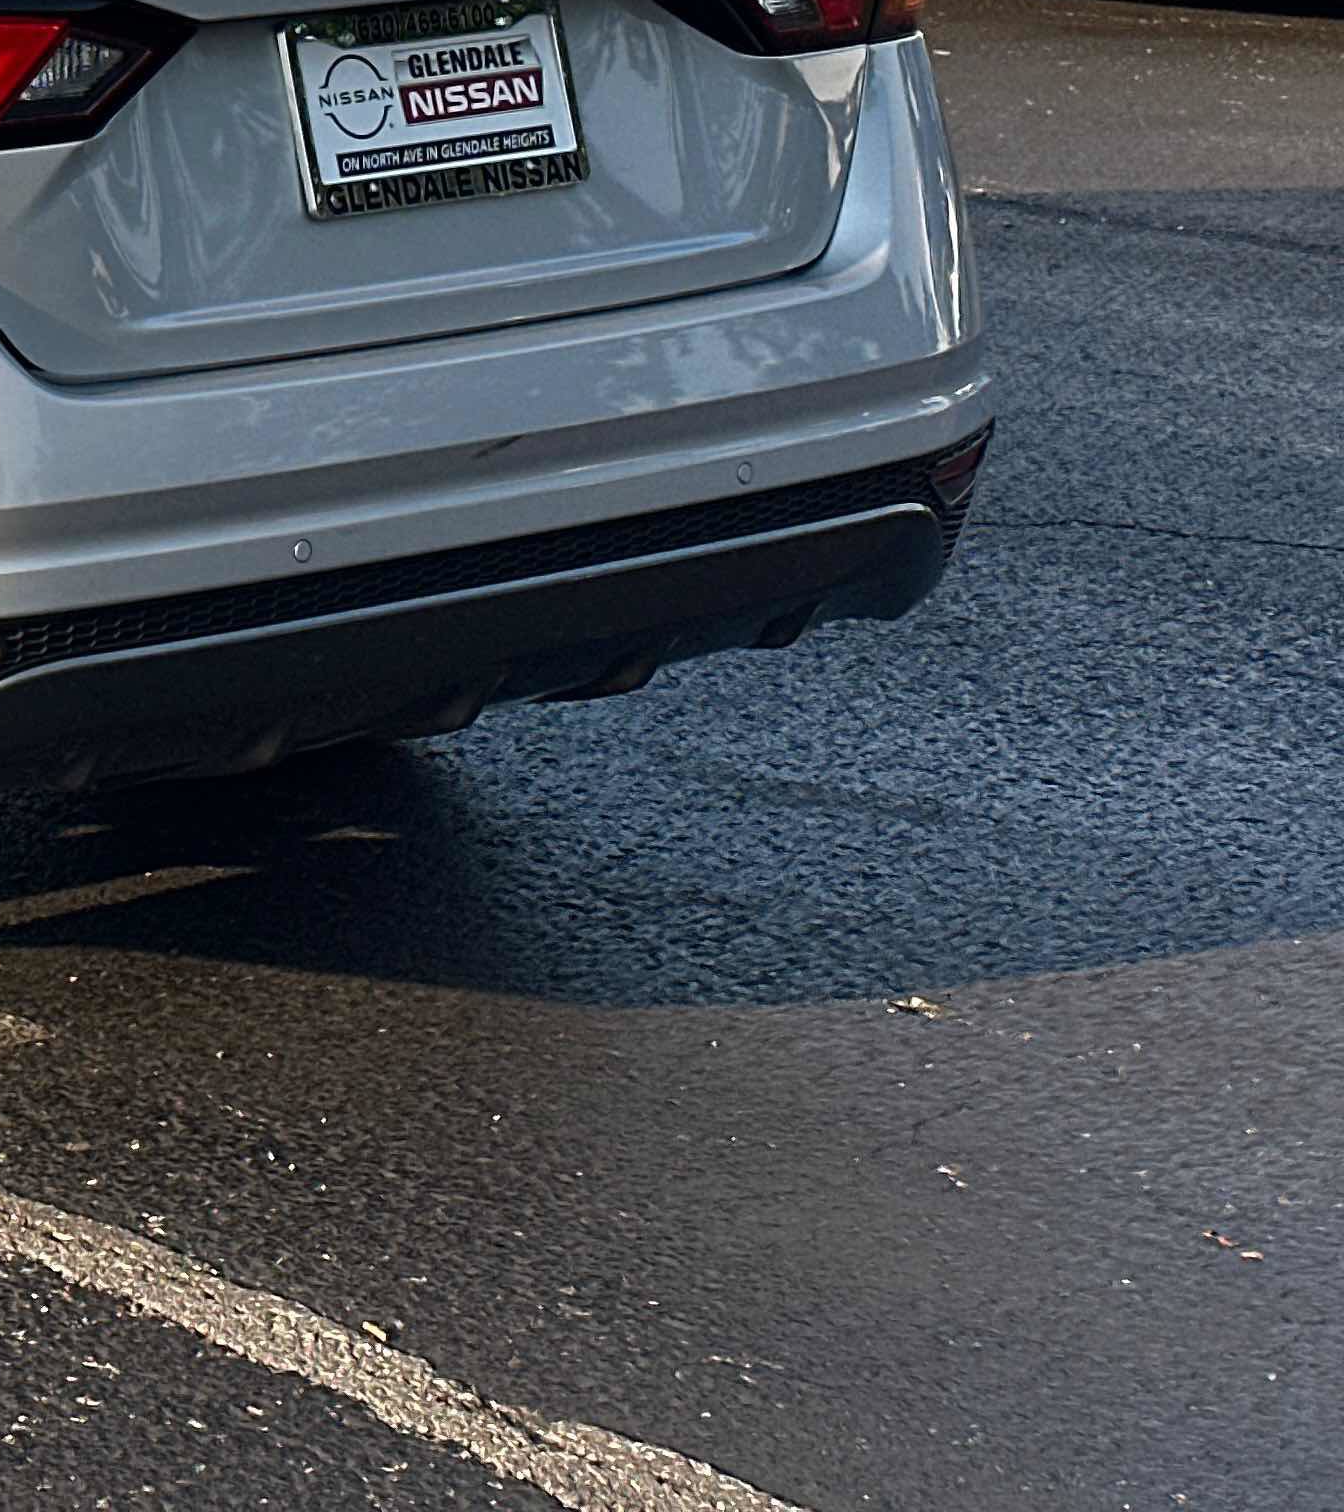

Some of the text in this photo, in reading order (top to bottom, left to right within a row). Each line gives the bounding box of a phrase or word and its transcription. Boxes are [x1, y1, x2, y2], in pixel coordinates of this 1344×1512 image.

[408, 40, 524, 79] GLENDALE
[319, 86, 395, 109] NISSAN
[408, 73, 540, 118] NISSAN
[342, 130, 551, 172] ON NORTH AVE IN GLENDALE HEIGHTS
[328, 153, 583, 215] GLENDALE NISSAN
